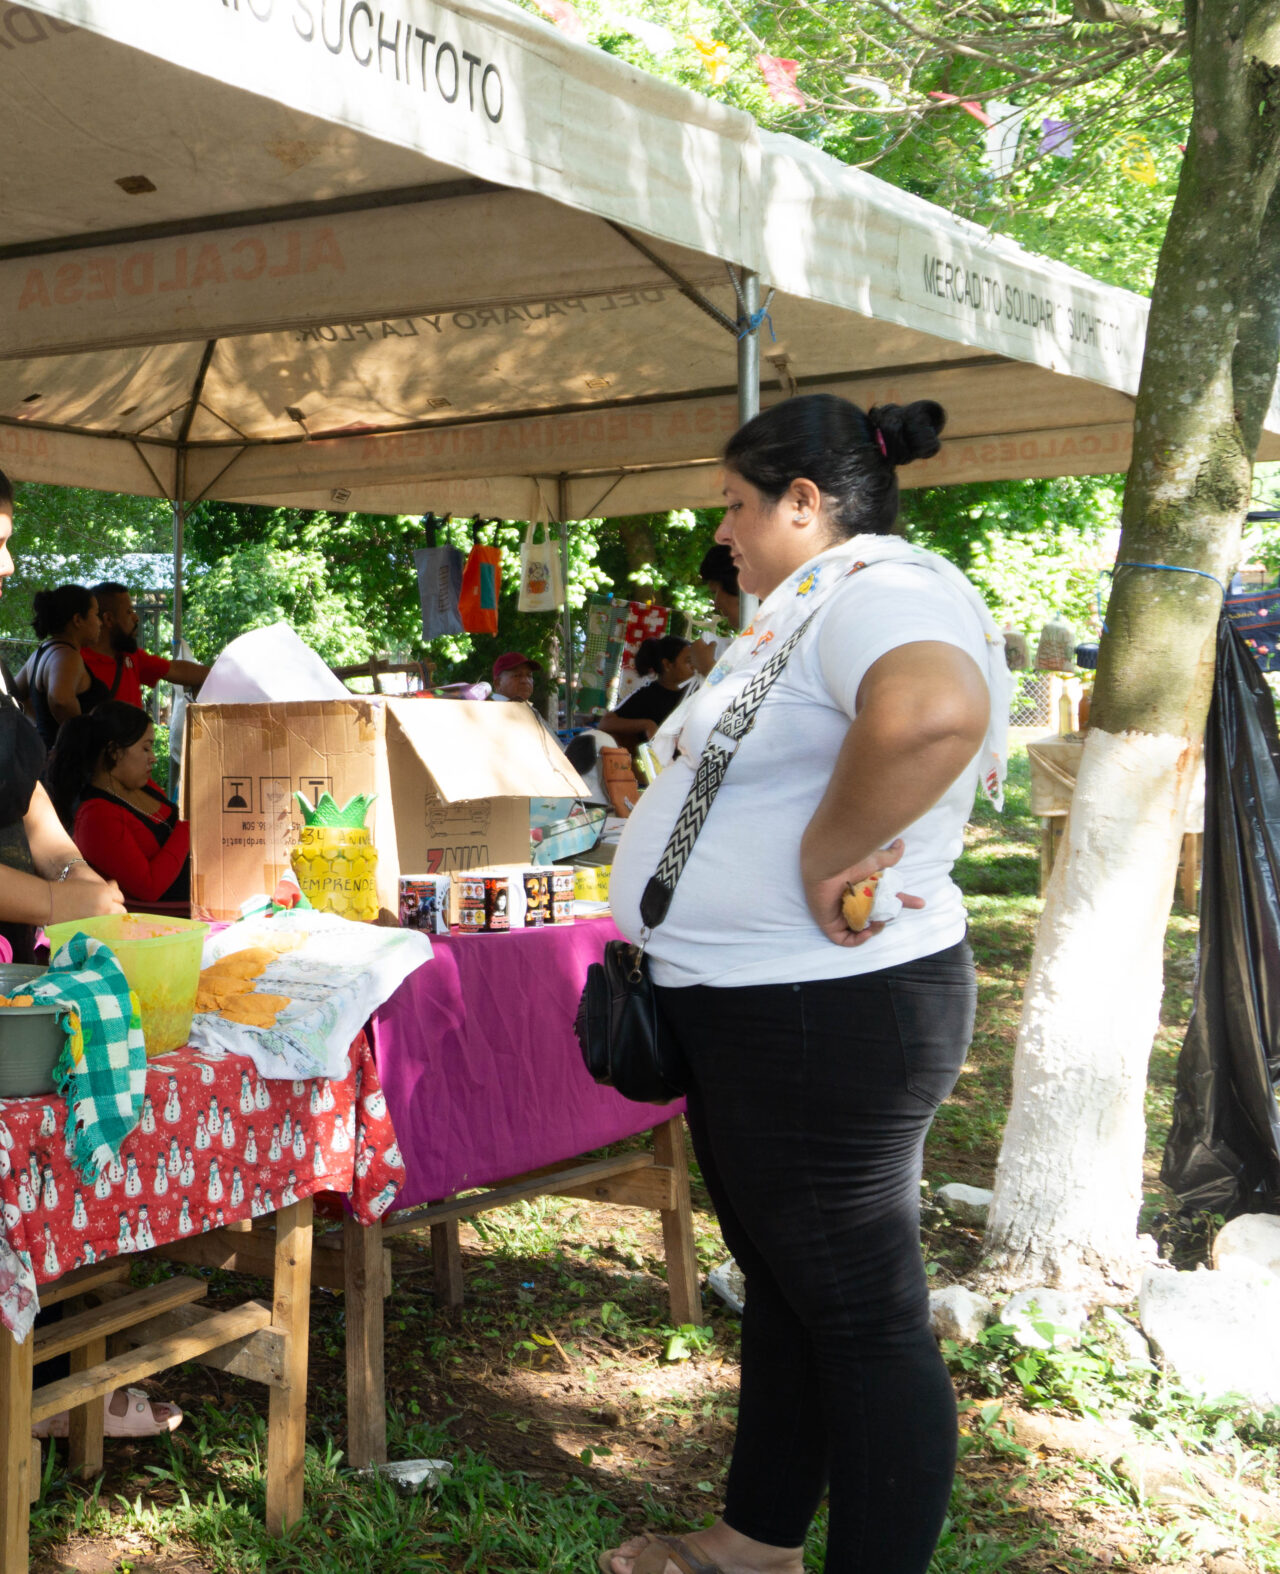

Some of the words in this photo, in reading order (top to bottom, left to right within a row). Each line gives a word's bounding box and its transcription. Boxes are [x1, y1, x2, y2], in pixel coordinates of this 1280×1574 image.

[292, 0, 503, 123] SUCHITOTO
[923, 253, 1001, 316] MERCADITO
[526, 877, 550, 907] 34
